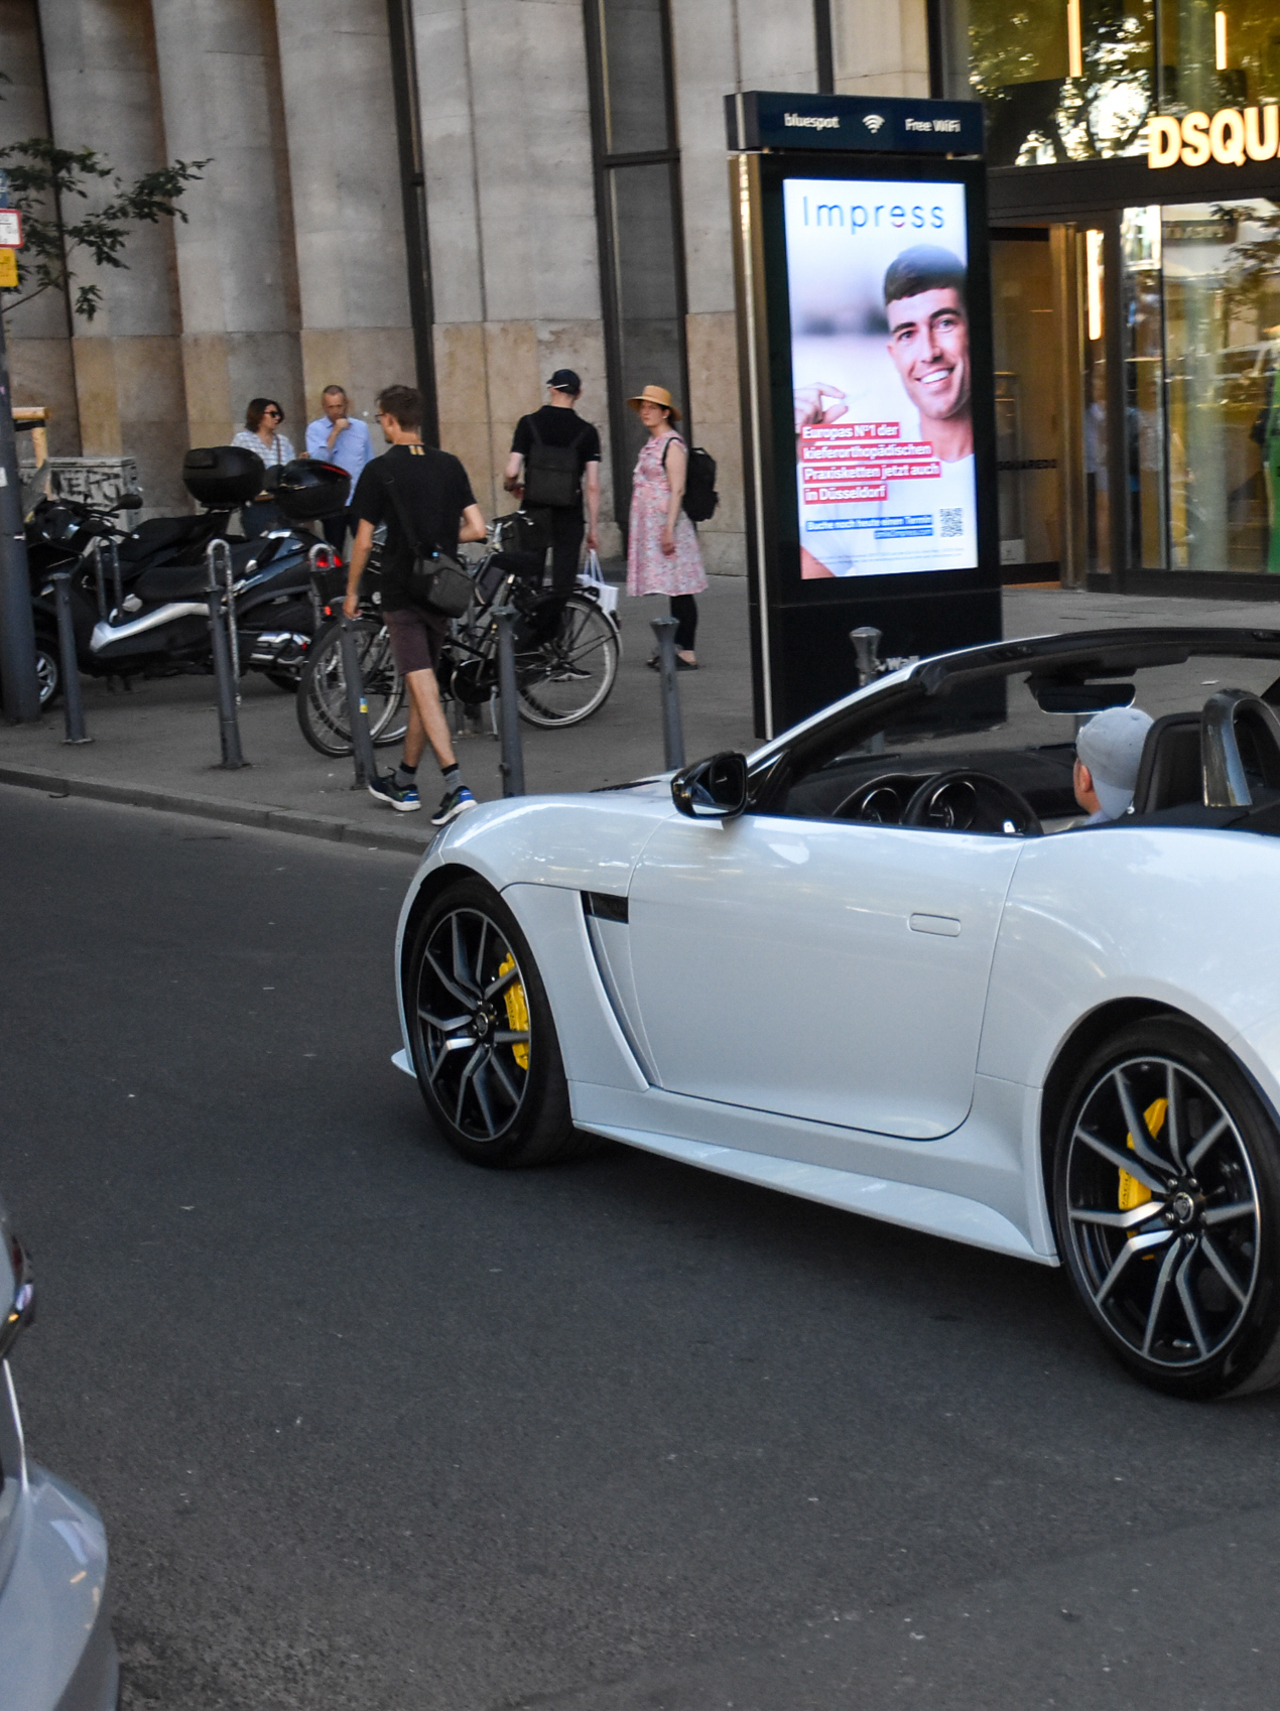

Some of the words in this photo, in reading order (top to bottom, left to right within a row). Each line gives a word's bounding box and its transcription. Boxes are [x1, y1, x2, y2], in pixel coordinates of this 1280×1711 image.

[784, 112, 840, 131] bluespot
[905, 118, 932, 132] Free
[933, 119, 962, 133] WiFi
[803, 196, 945, 235] Impress
[803, 426, 853, 440] Europas
[877, 424, 898, 436] der
[803, 444, 932, 460] kieferorthopädischen
[805, 467, 880, 481] Praxisketten
[881, 465, 909, 480] jetzt
[911, 463, 939, 476] auch
[805, 489, 818, 502] in
[820, 486, 886, 501] Düsseldorf
